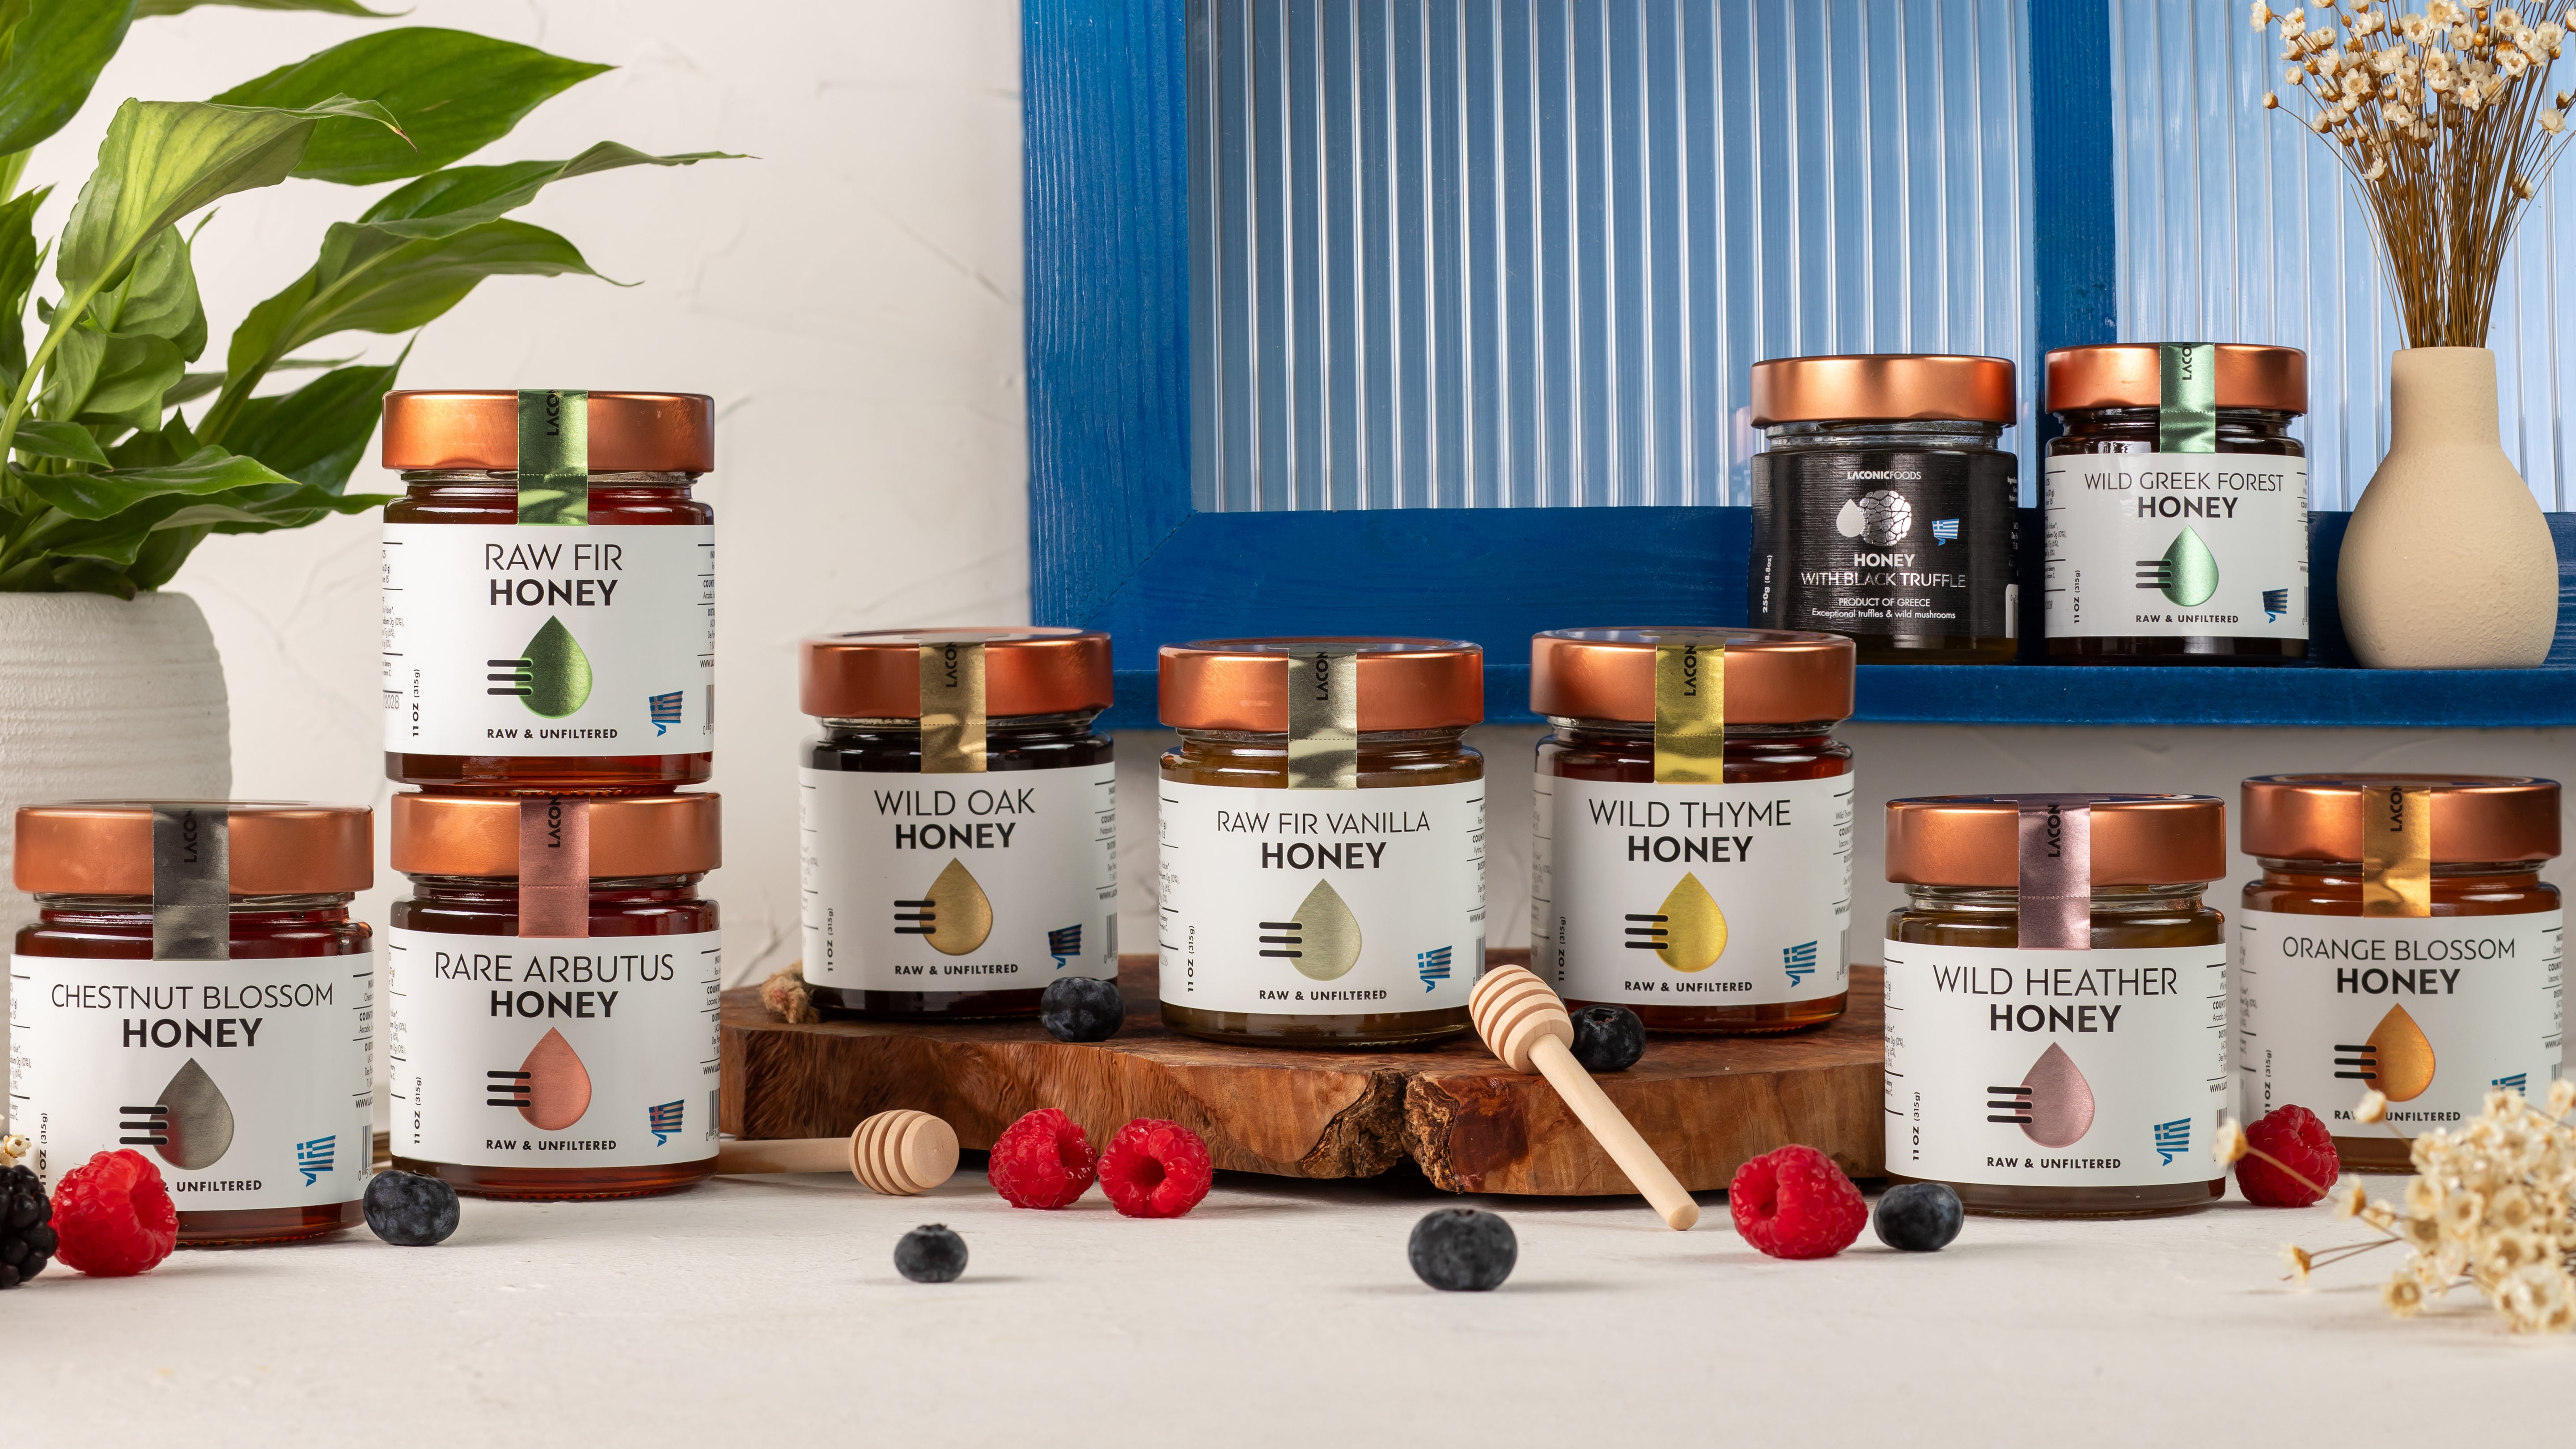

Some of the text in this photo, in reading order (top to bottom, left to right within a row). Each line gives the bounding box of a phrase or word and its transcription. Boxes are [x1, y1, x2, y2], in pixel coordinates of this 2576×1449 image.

[1847, 471, 1921, 480] LACONICFOODS
[2085, 472, 2284, 491] WILD GREEK FOREST
[2139, 496, 2238, 518] HONEY
[486, 544, 623, 570] RAW FIR
[1854, 553, 1915, 567] HONEY
[1801, 573, 1966, 587] WITH BLACK TRUFFLE
[491, 579, 618, 606] HONEY
[1839, 598, 1879, 606] PRODUCT
[1897, 598, 1930, 607] GREECE
[2074, 597, 2079, 612] OZ
[1812, 608, 1856, 618] Exceptional
[1858, 609, 1883, 617] truffles
[1895, 610, 1911, 618] wild
[1915, 610, 1955, 619] mushrooms
[2074, 615, 2079, 623] 11
[413, 703, 419, 722] OZ
[413, 726, 419, 736] 11
[488, 729, 617, 739] RAW & UNFILTERED
[874, 788, 1035, 816] WILD OAK
[548, 796, 561, 848] LACON
[1218, 811, 1430, 834] RAW FIR VANILLA
[1589, 799, 1791, 828] WILD THYME
[896, 823, 1016, 849] HONEY
[2047, 803, 2061, 858] LACON
[1263, 842, 1386, 869] HONEY
[1629, 836, 1753, 863] HONEY
[827, 940, 833, 957] OZ
[2284, 937, 2514, 960] ORANGE BLOSSOM
[436, 952, 673, 982] RARE ARBUTUS
[828, 962, 833, 971] 11
[1559, 949, 1564, 967] OZ
[895, 964, 1018, 975] RAW & UNFILTERED
[1188, 959, 1193, 977] OZ
[1559, 971, 1564, 981] 11
[1188, 982, 1193, 992] 11
[1625, 982, 1752, 991] RAW & UNFILTERED
[1933, 965, 2177, 996] WILD HEATHER
[2338, 968, 2460, 994] HONEY
[52, 983, 332, 1009] CHESTNUT BLOSSOM
[491, 990, 618, 1018] HONEY
[1260, 990, 1386, 1000] RAW & UNFILTERED
[1991, 1004, 2121, 1033] HONEY
[123, 1018, 263, 1048] HONEY
[2265, 1082, 2270, 1100] OZ
[415, 1111, 419, 1129] OZ
[2334, 1110, 2460, 1121] RA UNFILTERED
[415, 1134, 419, 1144] 11
[1913, 1126, 1919, 1145] OZ
[487, 1140, 616, 1150] RAW & UNFILTERED
[40, 1150, 46, 1170] OZ
[1913, 1150, 1919, 1160] 11
[1987, 1157, 2120, 1169] RAW & UNFILTERED
[177, 1180, 262, 1192] UNFILTERED
